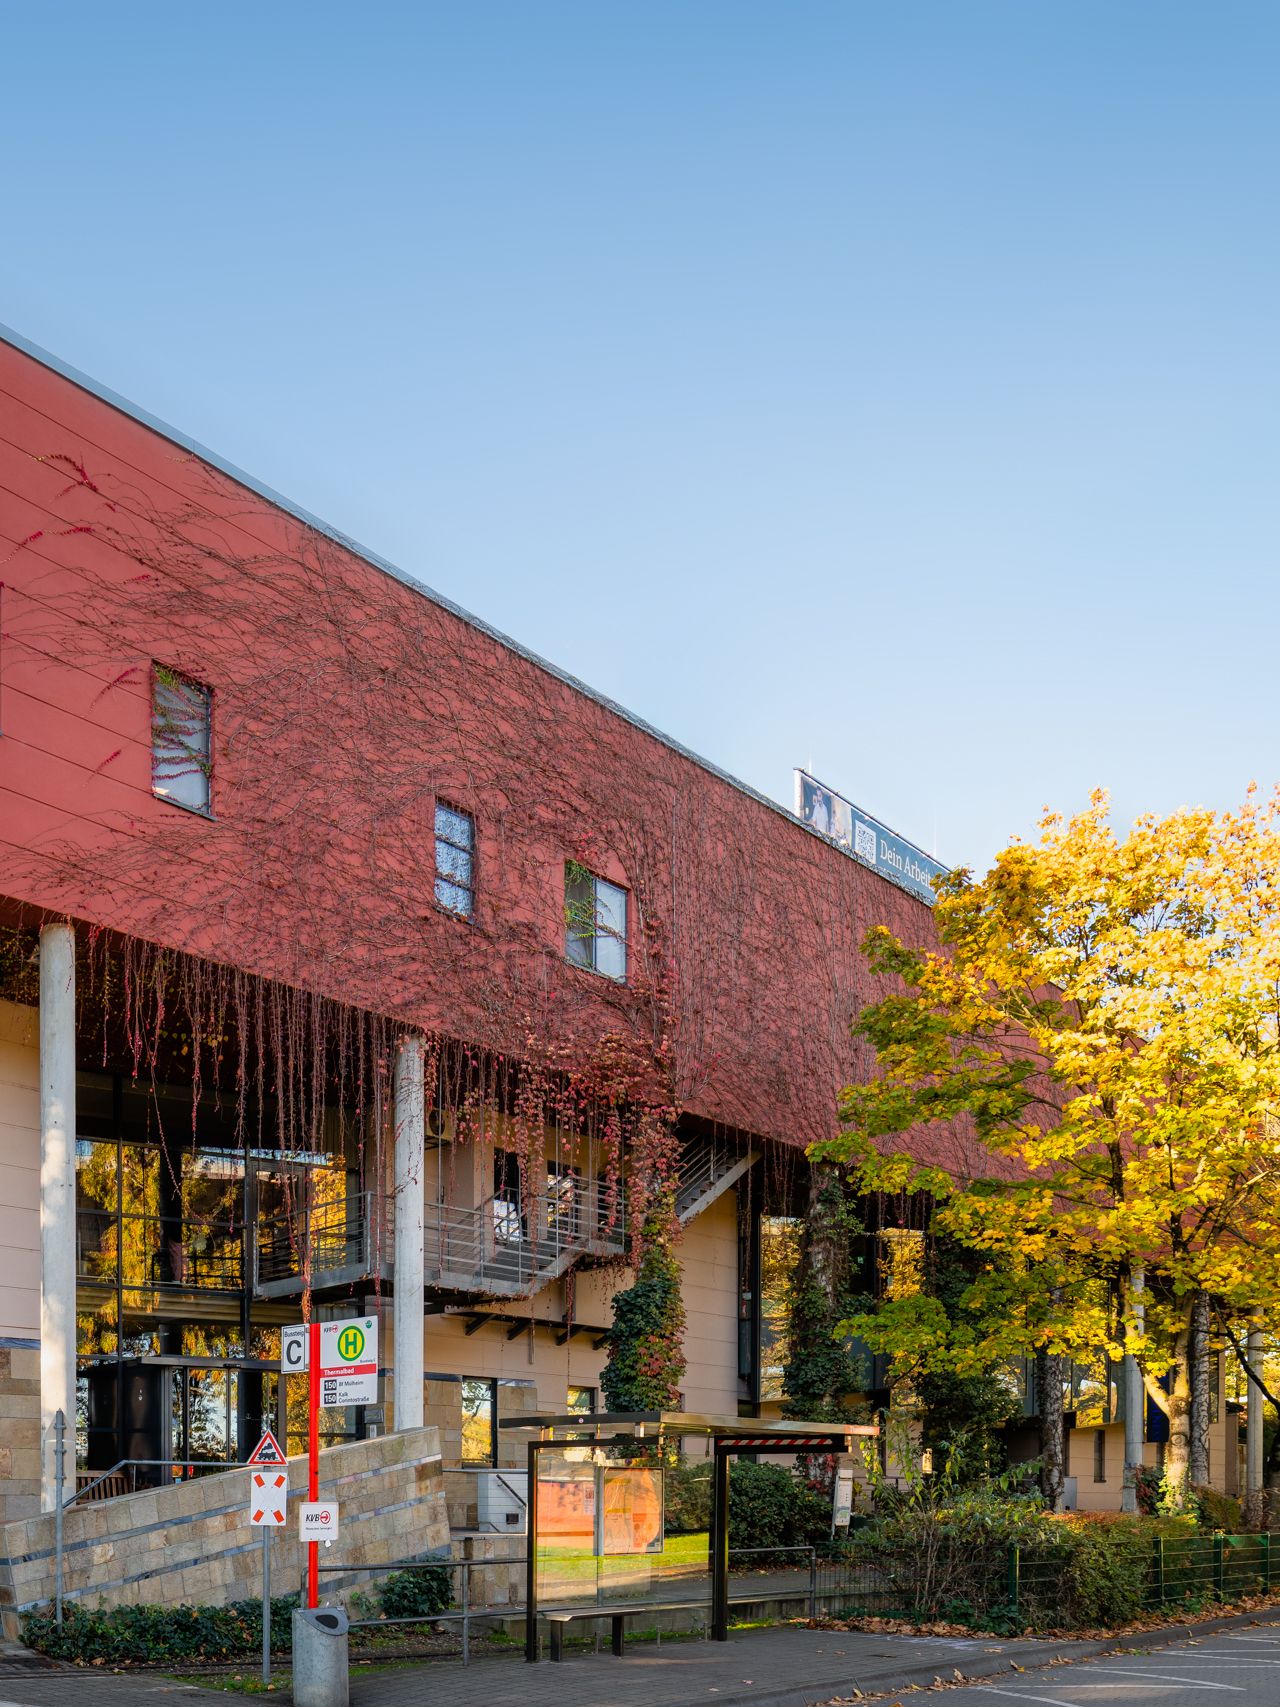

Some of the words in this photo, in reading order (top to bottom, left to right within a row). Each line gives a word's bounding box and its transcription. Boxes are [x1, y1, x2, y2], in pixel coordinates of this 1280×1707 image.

[880, 840, 902, 870] Dein
[284, 1330, 304, 1338] Bussteig
[345, 1332, 357, 1354] H
[286, 1339, 302, 1365] C
[324, 1368, 354, 1376] Thermalbad
[325, 1381, 336, 1389] 150
[325, 1394, 336, 1403] 150
[306, 1514, 320, 1522] KVB
